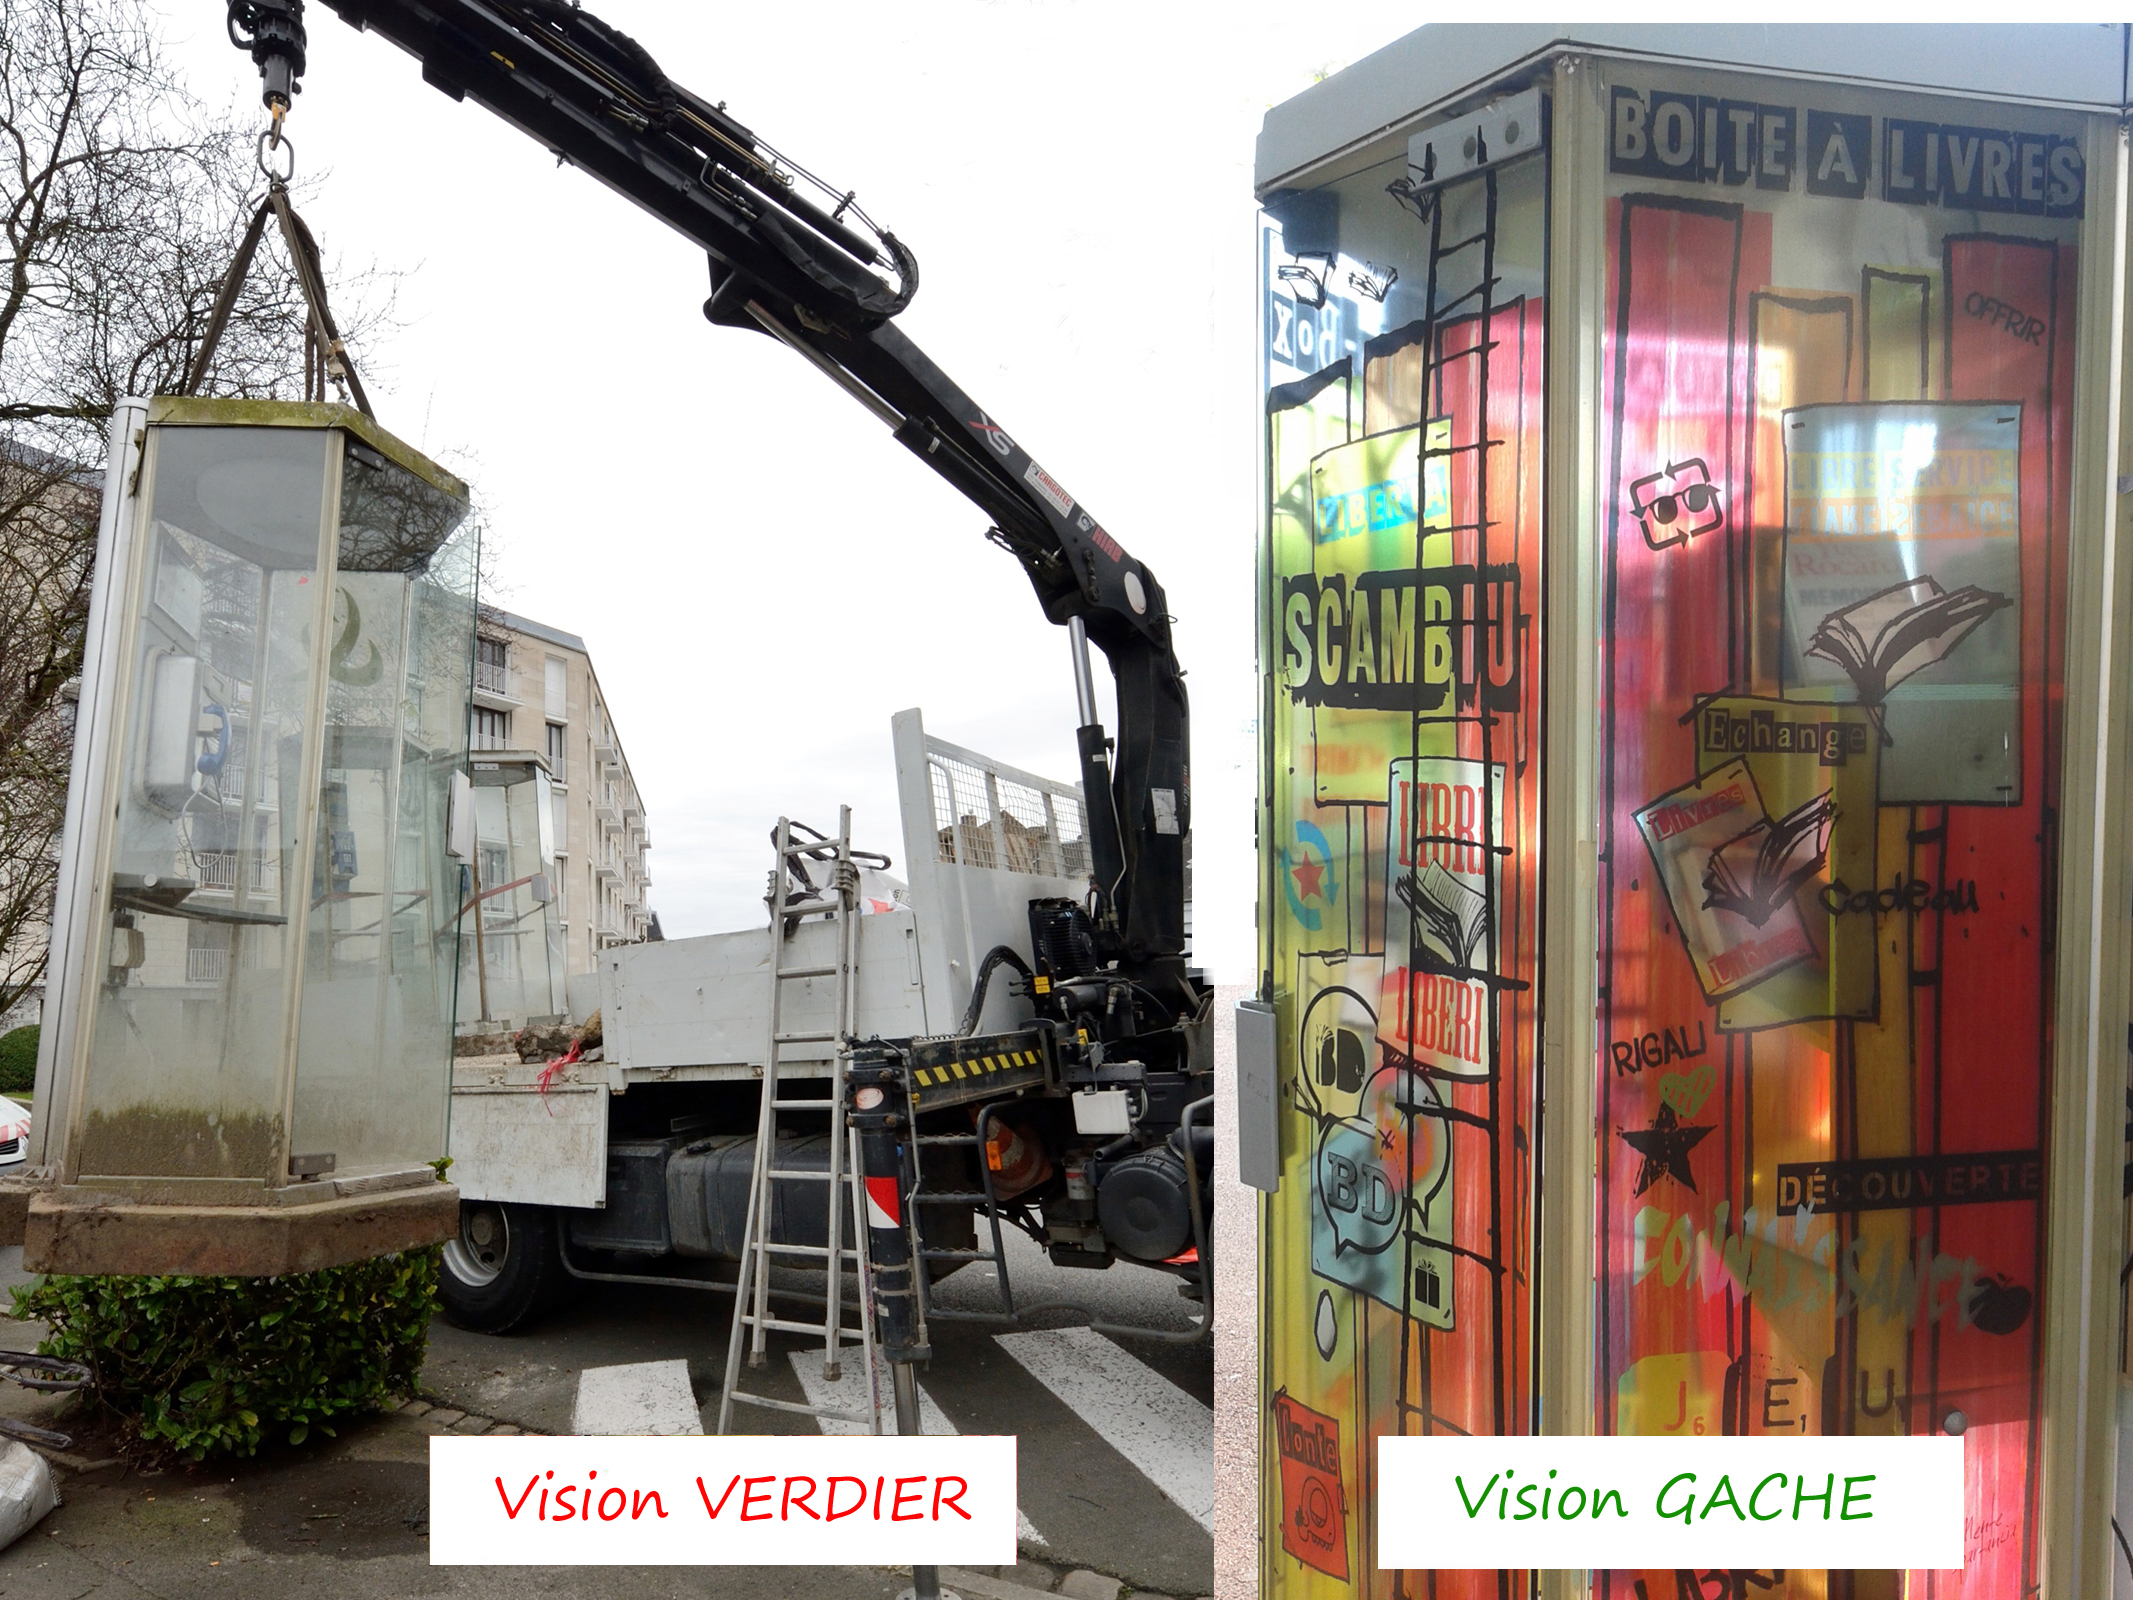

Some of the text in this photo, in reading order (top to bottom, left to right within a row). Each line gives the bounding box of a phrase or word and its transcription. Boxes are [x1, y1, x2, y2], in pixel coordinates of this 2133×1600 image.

[1614, 98, 2081, 208] BOITE À LIVRES
[1964, 290, 2046, 347] OFFRIR
[968, 411, 1015, 456] XS
[1038, 471, 1073, 508] CARGOTEC
[1791, 455, 2014, 490] LIBRE SERVICE
[1091, 526, 1124, 564] HIAB
[1283, 583, 1516, 688] SCAMBIU
[1705, 710, 1866, 761] Echange
[1647, 787, 1745, 838] Livres
[1395, 965, 1485, 1066] LIBERI
[1326, 1150, 1397, 1226] BD
[1778, 1160, 2040, 1209] DÉCOUVERTE
